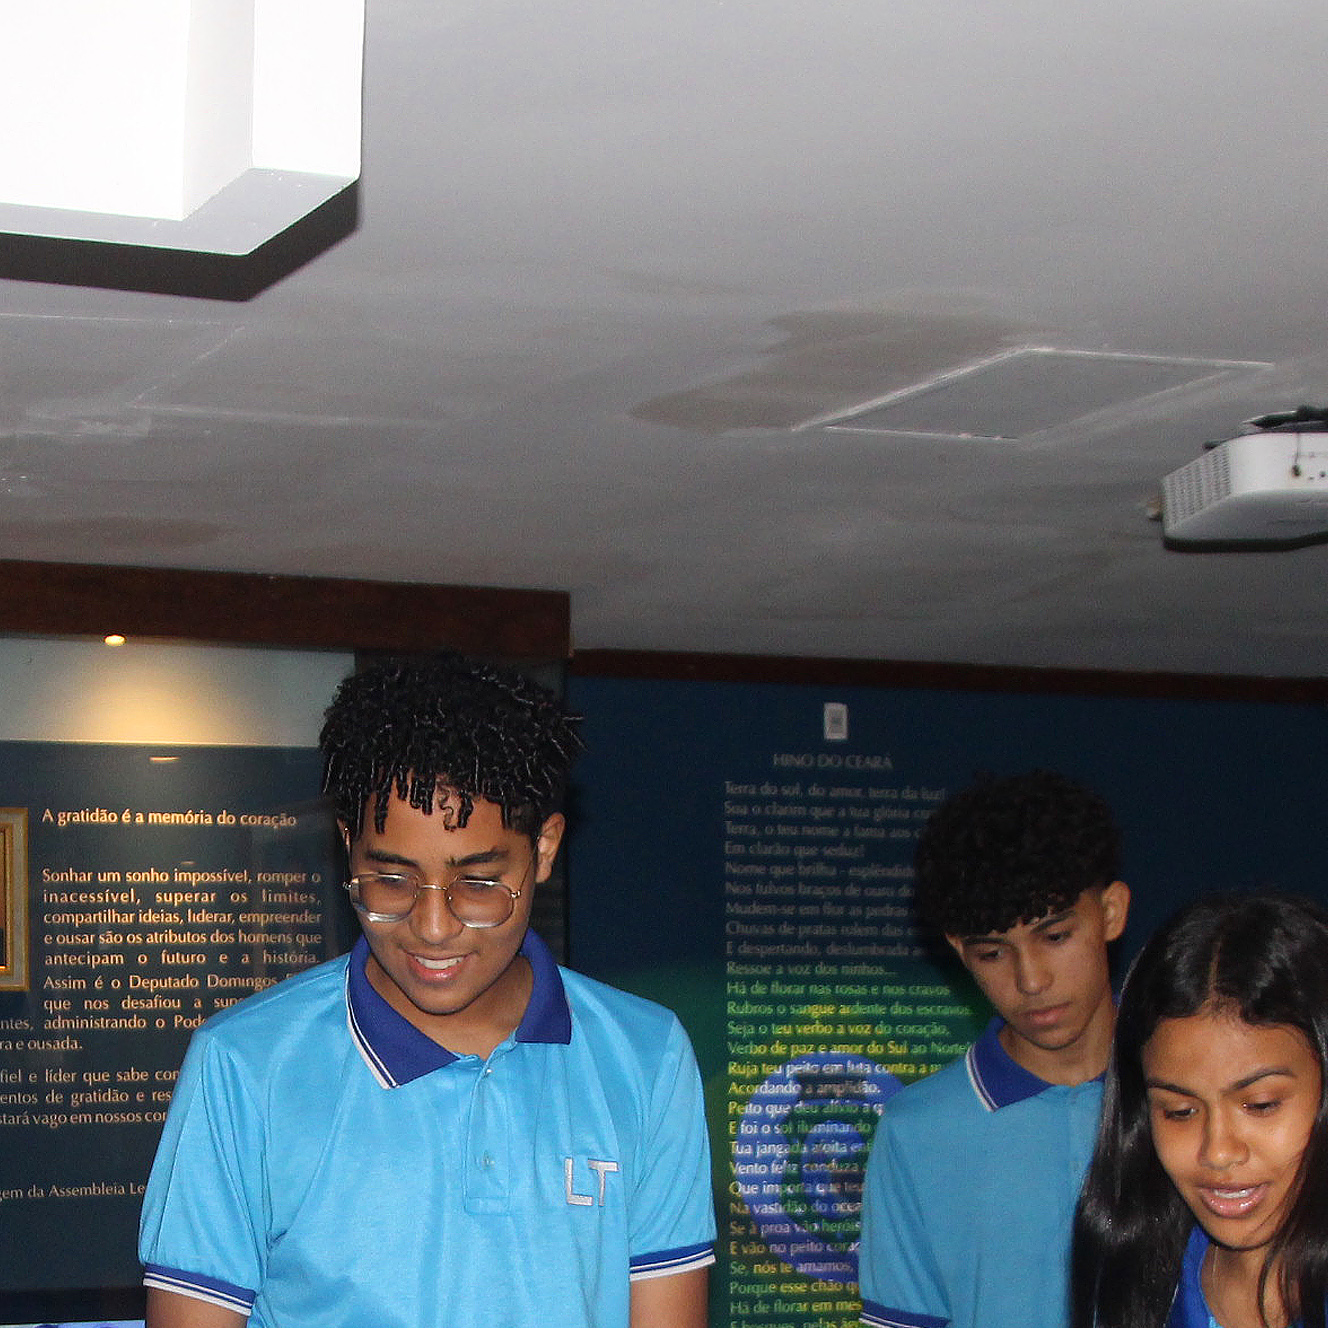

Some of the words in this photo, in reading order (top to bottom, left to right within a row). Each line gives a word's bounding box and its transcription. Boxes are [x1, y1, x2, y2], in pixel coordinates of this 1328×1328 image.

[42, 808, 54, 822] A
[57, 808, 118, 827] gratidão
[122, 808, 132, 823] é
[135, 813, 145, 823] a
[148, 809, 213, 826] memória
[217, 810, 236, 825] do
[240, 812, 297, 828] coração
[42, 867, 93, 884] Sonhar
[97, 871, 121, 884] um
[126, 867, 169, 884] sonho
[174, 868, 252, 887] impossível,
[257, 871, 307, 887] romper
[312, 873, 321, 883] o
[43, 888, 142, 905] inacessível,
[155, 891, 217, 907] superar
[230, 892, 248, 904] os
[262, 889, 321, 906] limites,
[43, 909, 135, 928] compartilhar
[139, 909, 184, 926] ideias,
[188, 909, 236, 926] liderar,
[239, 909, 322, 927] empreender
[43, 934, 52, 944] e
[56, 934, 96, 945] ousar
[99, 931, 123, 945] são
[127, 933, 143, 944] os
[146, 930, 207, 945] atributos
[210, 930, 235, 945] dos
[238, 930, 292, 945] homens
[296, 933, 322, 947] que
[45, 951, 124, 969] antecipam
[137, 954, 148, 964] o
[161, 951, 207, 964] futuro
[219, 953, 228, 964] e
[241, 953, 250, 964] a
[43, 976, 87, 990] Assim
[94, 975, 103, 990] é
[111, 978, 121, 989] o
[129, 974, 199, 992] Deputado
[43, 998, 71, 1012] que
[84, 998, 109, 1010] nos
[121, 995, 181, 1010] desafiou
[194, 997, 202, 1008] a
[44, 1014, 146, 1029] administrando
[155, 1017, 165, 1029] o
[727, 1021, 754, 1036] Seja
[759, 1025, 768, 1034] o
[772, 1023, 792, 1034] teu
[795, 1021, 833, 1034] verbo
[837, 1025, 844, 1034] a
[848, 1024, 872, 1034] voz
[874, 1022, 891, 1034] do
[16, 1040, 24, 1050] e
[28, 1036, 83, 1050] ousada.
[728, 1041, 768, 1054] Verbo
[771, 1041, 787, 1054] de
[791, 1044, 815, 1057] paz
[820, 1044, 827, 1053] e
[830, 1044, 863, 1053] amor
[866, 1041, 884, 1054] do
[888, 1041, 909, 1053] Sul
[910, 1044, 927, 1054] ao
[728, 1062, 758, 1077] Ruja
[761, 1062, 782, 1074] teu
[785, 1060, 819, 1076] peito
[822, 1063, 844, 1074] em
[847, 1060, 871, 1074] luta
[875, 1062, 915, 1074] contra
[918, 1064, 926, 1074] a
[0, 1069, 21, 1083] fiel
[28, 1072, 37, 1083] e
[45, 1068, 78, 1083] líder
[83, 1071, 110, 1087] que
[116, 1068, 149, 1082] sabe
[45, 1089, 64, 1104] de
[70, 1088, 129, 1107] gratidão
[136, 1092, 145, 1103] e
[33, 1114, 67, 1129] vago
[70, 1114, 92, 1124] em
[95, 1112, 142, 1124] nossos
[27, 1182, 45, 1197] da
[49, 1181, 125, 1198] Assembleia
[565, 1157, 619, 1207] LT
